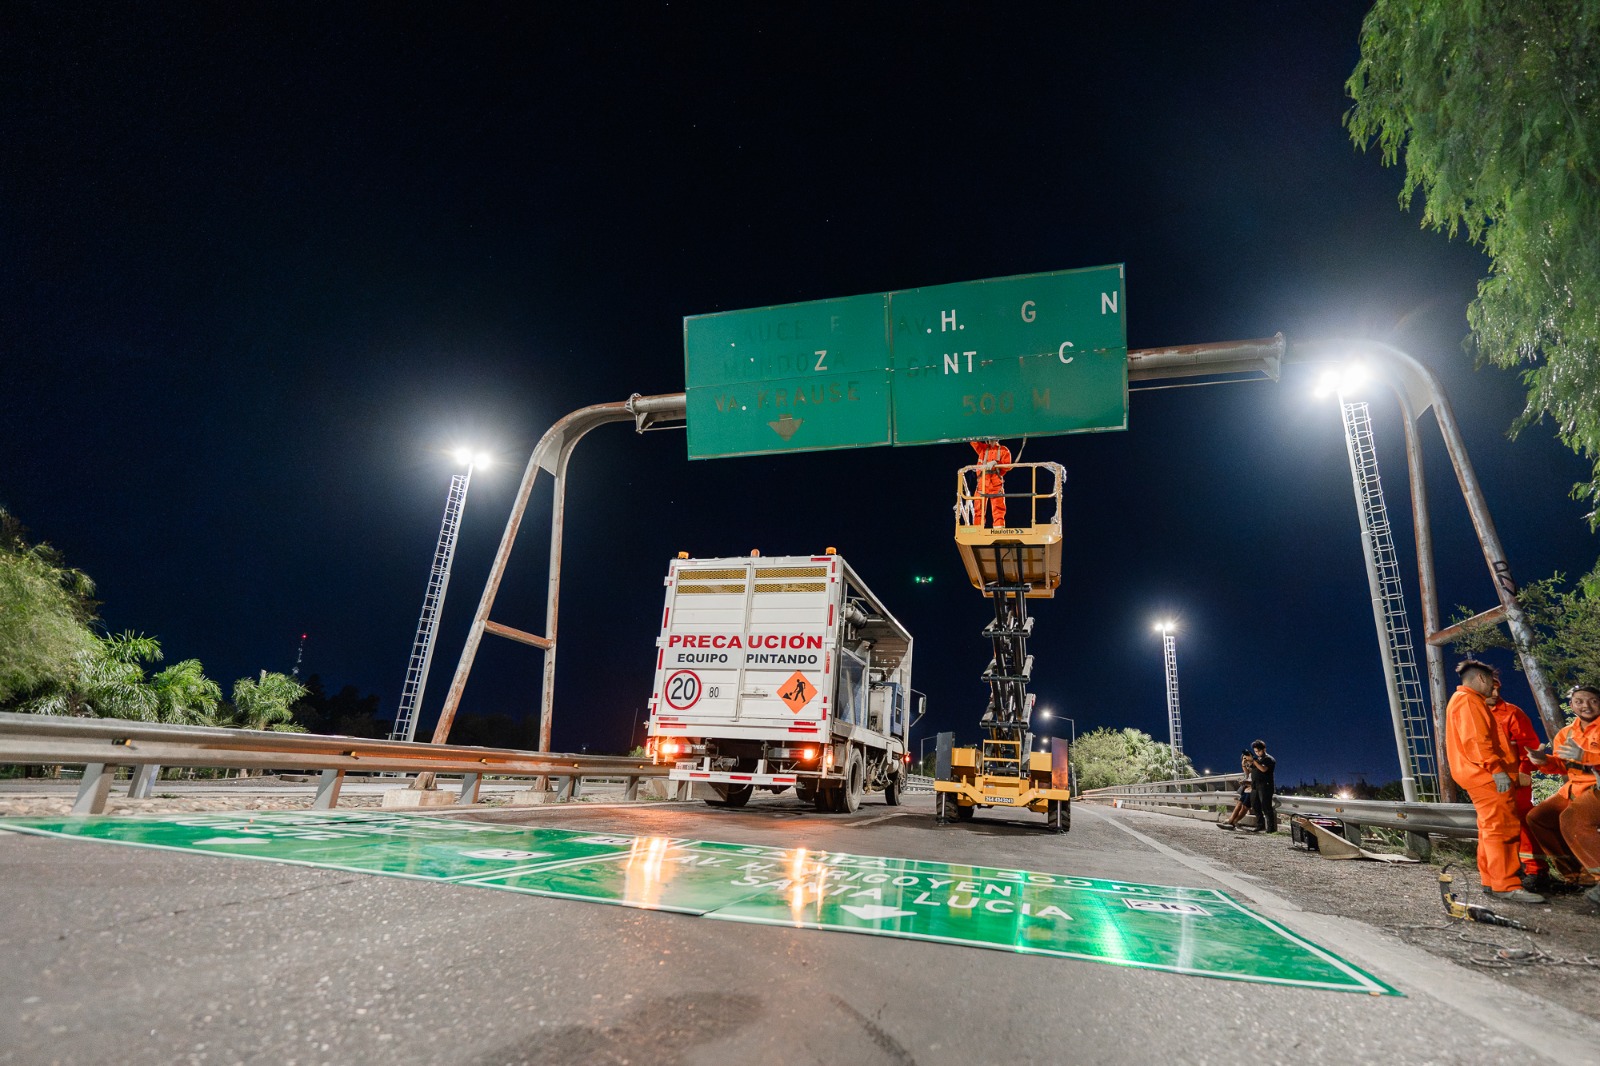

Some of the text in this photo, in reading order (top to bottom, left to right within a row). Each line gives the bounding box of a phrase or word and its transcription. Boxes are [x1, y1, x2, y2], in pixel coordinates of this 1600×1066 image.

[756, 380, 861, 409] KRAUSE
[962, 390, 1014, 417] 500
[677, 653, 818, 665] EQUIPO PINTANDO
[671, 677, 720, 701] 20 80
[736, 847, 888, 868] SAIDA
[730, 875, 1074, 921] SANTA LUCIA
